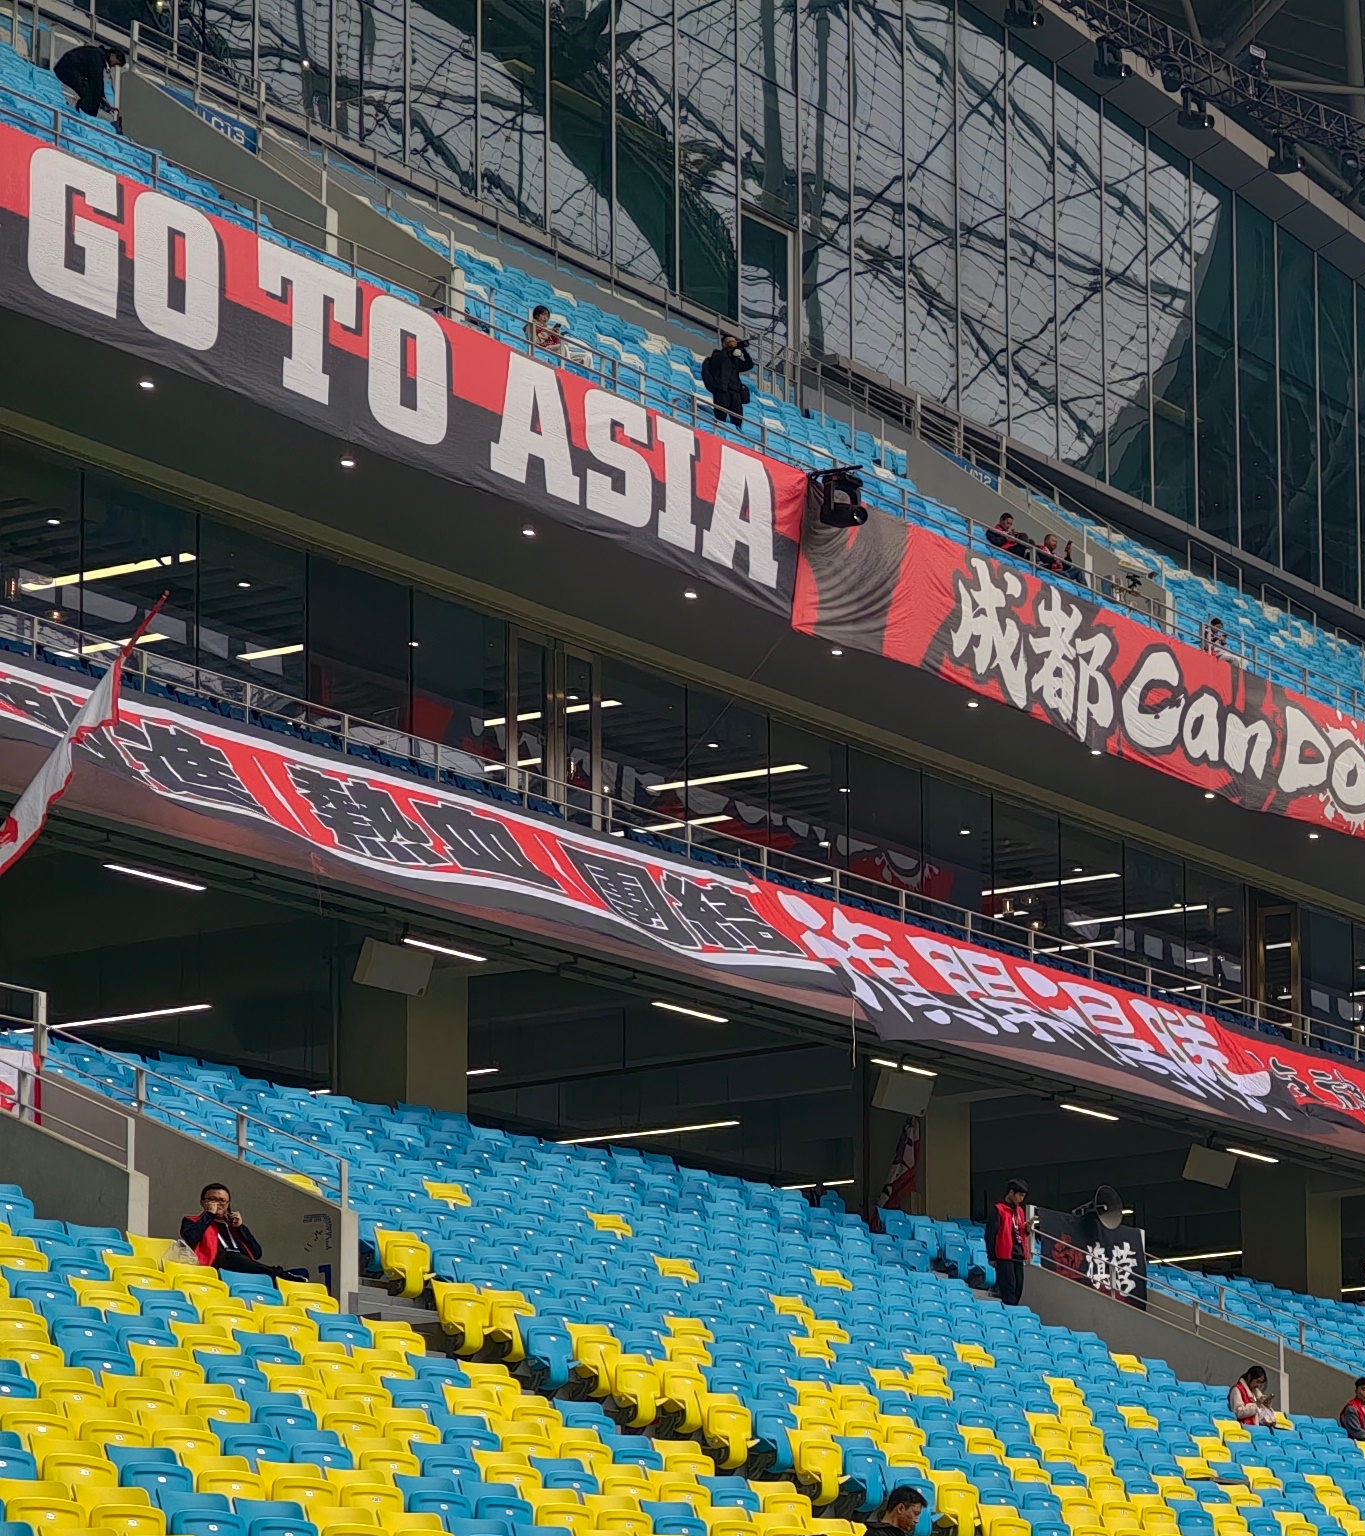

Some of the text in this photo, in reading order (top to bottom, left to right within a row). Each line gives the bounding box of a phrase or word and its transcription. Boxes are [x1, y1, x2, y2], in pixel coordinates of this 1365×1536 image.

[28, 147, 780, 590] GO TO ASIA
[950, 555, 1115, 742] 成都
[285, 761, 567, 895] 熱血
[554, 838, 810, 959] 團結
